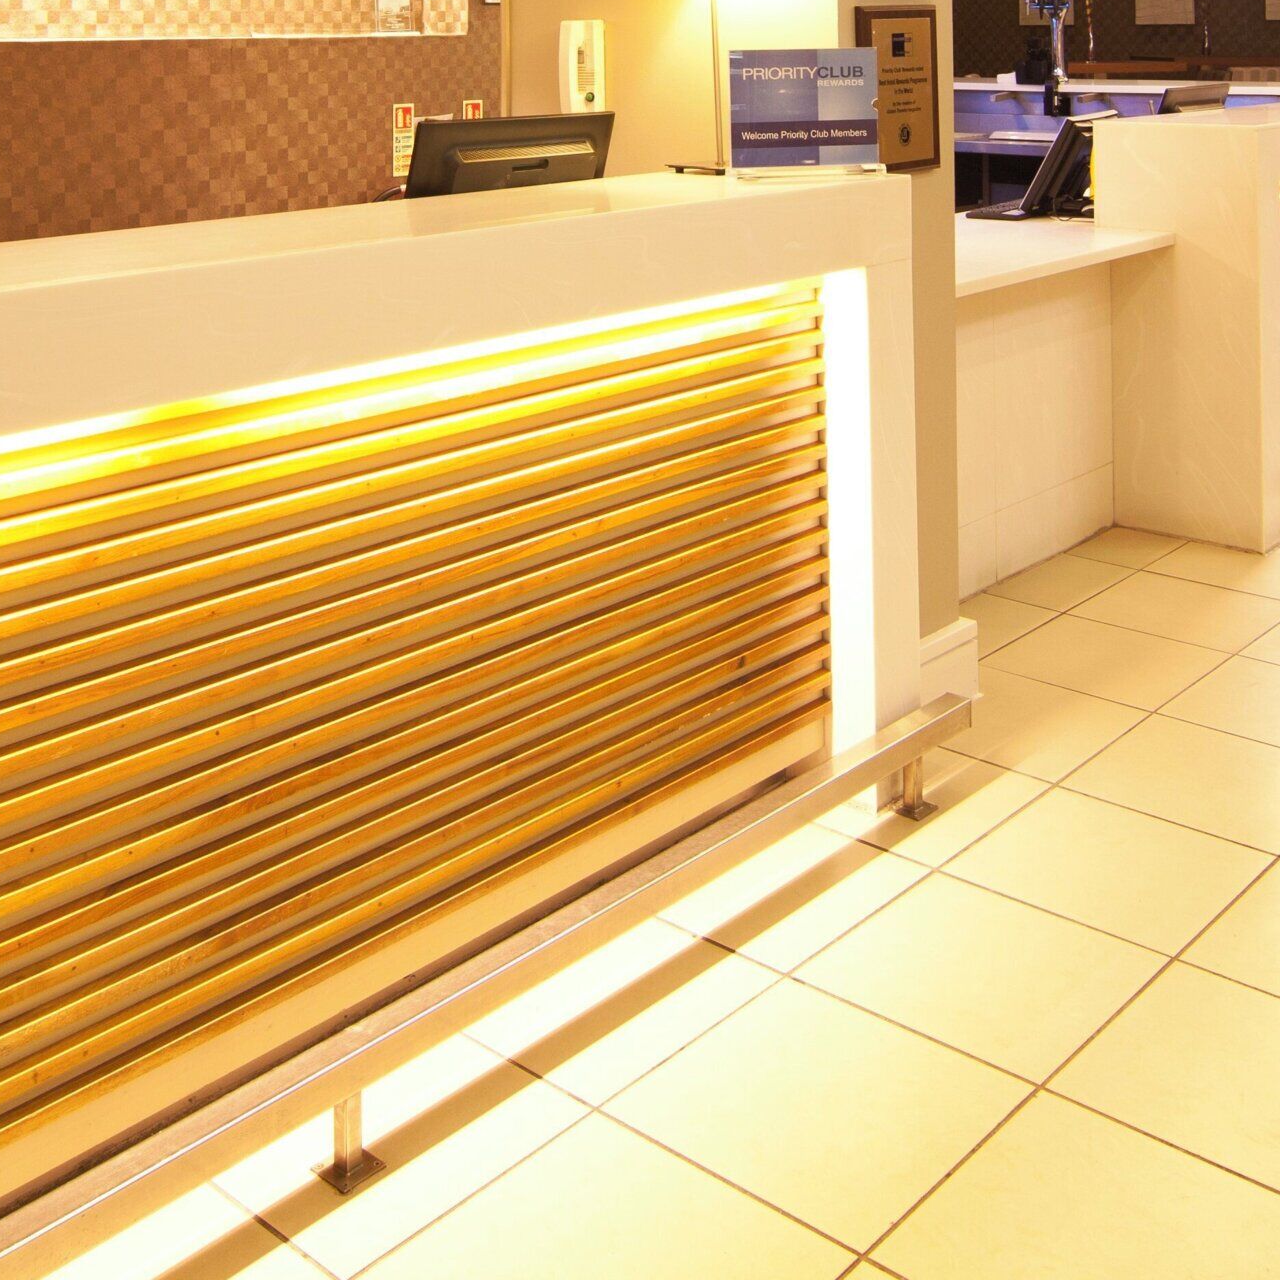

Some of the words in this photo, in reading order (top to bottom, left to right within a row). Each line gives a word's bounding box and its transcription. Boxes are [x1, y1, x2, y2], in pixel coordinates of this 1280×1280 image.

[817, 79, 865, 87] REWARDS
[741, 131, 779, 140] Welcome
[781, 130, 808, 140] Priority
[810, 129, 829, 138] Club
[831, 129, 867, 137] Members
